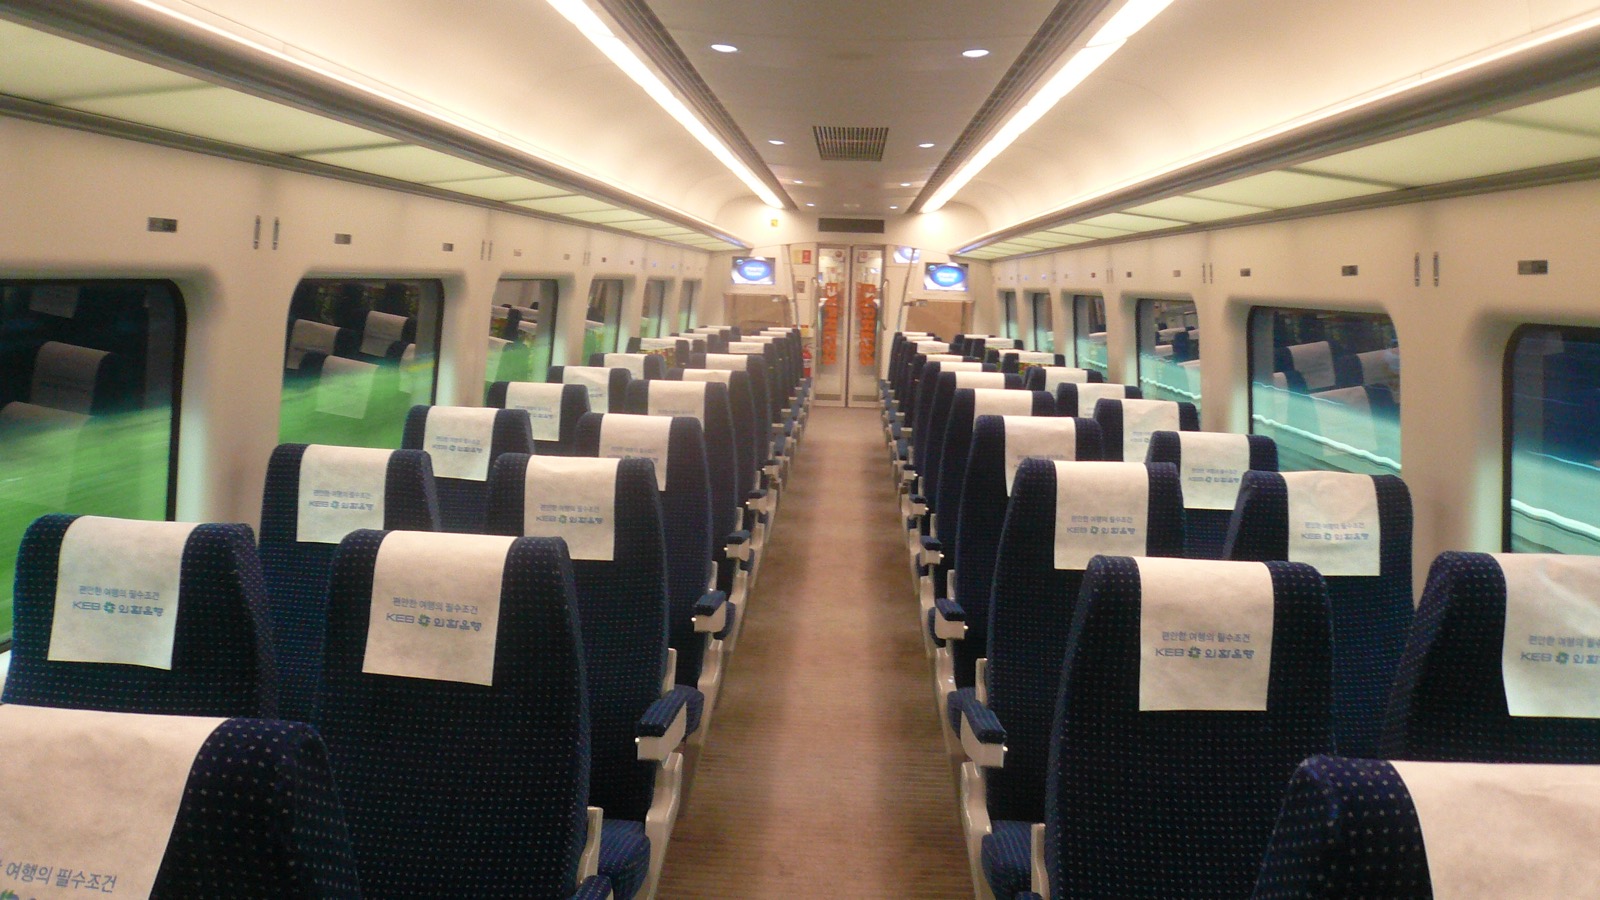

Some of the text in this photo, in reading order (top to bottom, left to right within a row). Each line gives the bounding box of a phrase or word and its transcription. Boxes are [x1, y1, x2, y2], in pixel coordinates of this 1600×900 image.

[72, 601, 101, 611] KEB
[386, 613, 415, 624] KEB
[1155, 648, 1185, 657] KEB
[1520, 651, 1553, 662] KEB
[6, 862, 117, 893] 여행의 필수조건
